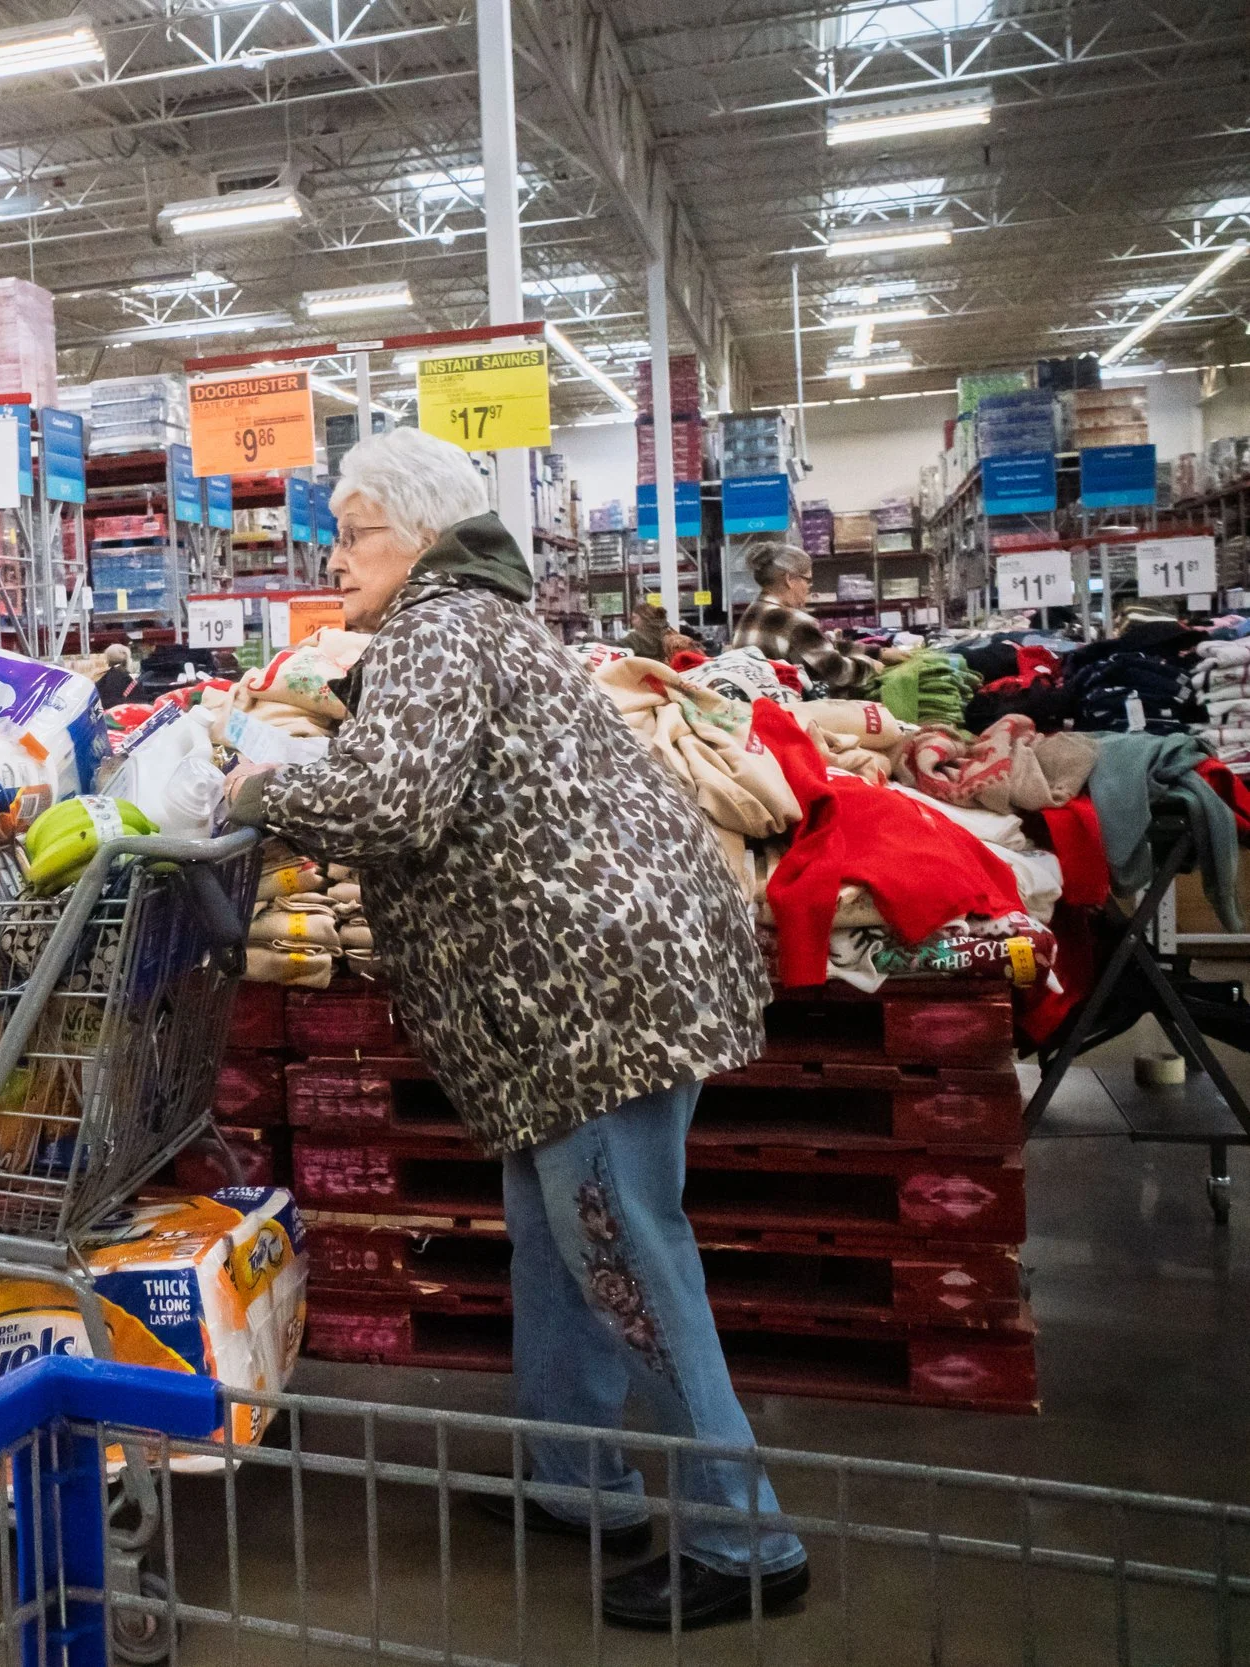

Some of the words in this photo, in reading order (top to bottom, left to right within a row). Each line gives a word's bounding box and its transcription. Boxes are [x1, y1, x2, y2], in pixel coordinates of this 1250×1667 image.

[424, 357, 479, 374] INSTANT
[482, 352, 539, 370] SAVINGS
[194, 375, 299, 400] DOORBUSTER
[193, 401, 222, 411] STATE
[224, 399, 235, 408] OF
[238, 397, 261, 406] MINE
[932, 951, 973, 969] THE
[143, 1278, 190, 1297] THICK
[149, 1300, 156, 1311] &
[159, 1299, 191, 1312] LONG
[150, 1313, 192, 1326] LASTING
